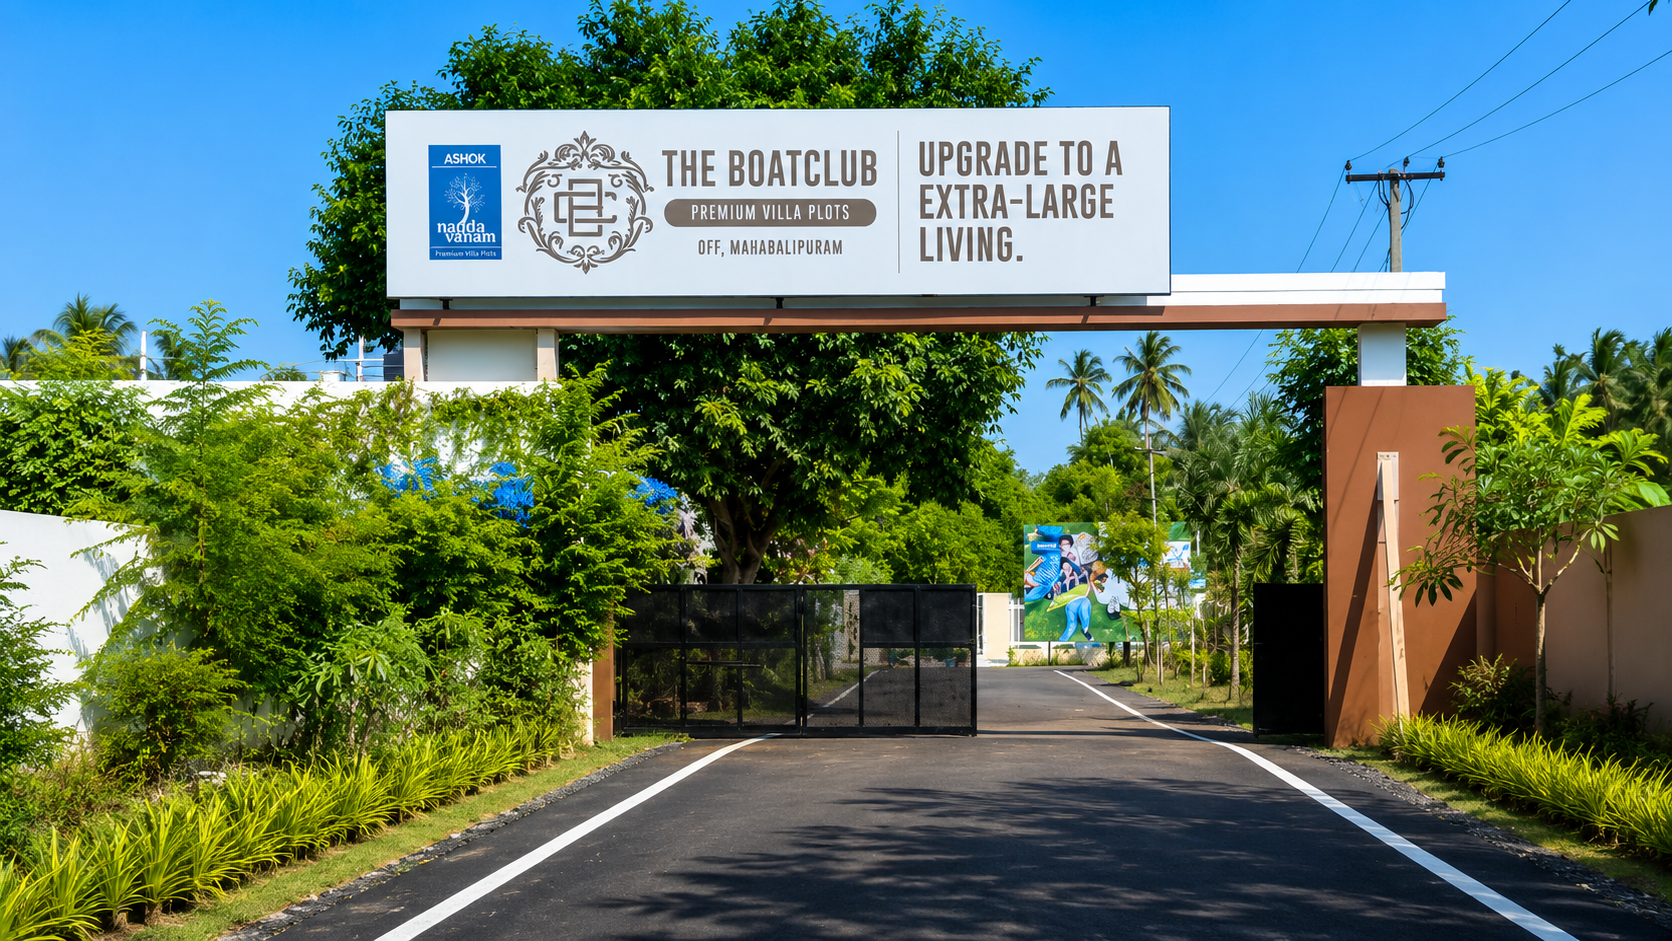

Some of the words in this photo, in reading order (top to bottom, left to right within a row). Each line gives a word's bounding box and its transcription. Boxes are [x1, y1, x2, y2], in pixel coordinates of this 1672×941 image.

[444, 153, 487, 165] ASHOK
[662, 149, 716, 187] THE
[728, 149, 877, 188] BOATCLUB
[919, 140, 1048, 177] UPGRADE
[1059, 140, 1093, 177] TO
[1104, 140, 1123, 176] A
[691, 204, 756, 220] PREMIUM
[762, 204, 802, 220] VILLA
[809, 204, 850, 220] PLOTS
[919, 183, 1114, 220] EXTRA-LARGE
[698, 239, 725, 258] OFF,
[730, 239, 843, 255] MAHABALIPURAM
[919, 226, 1024, 263] LIVING.
